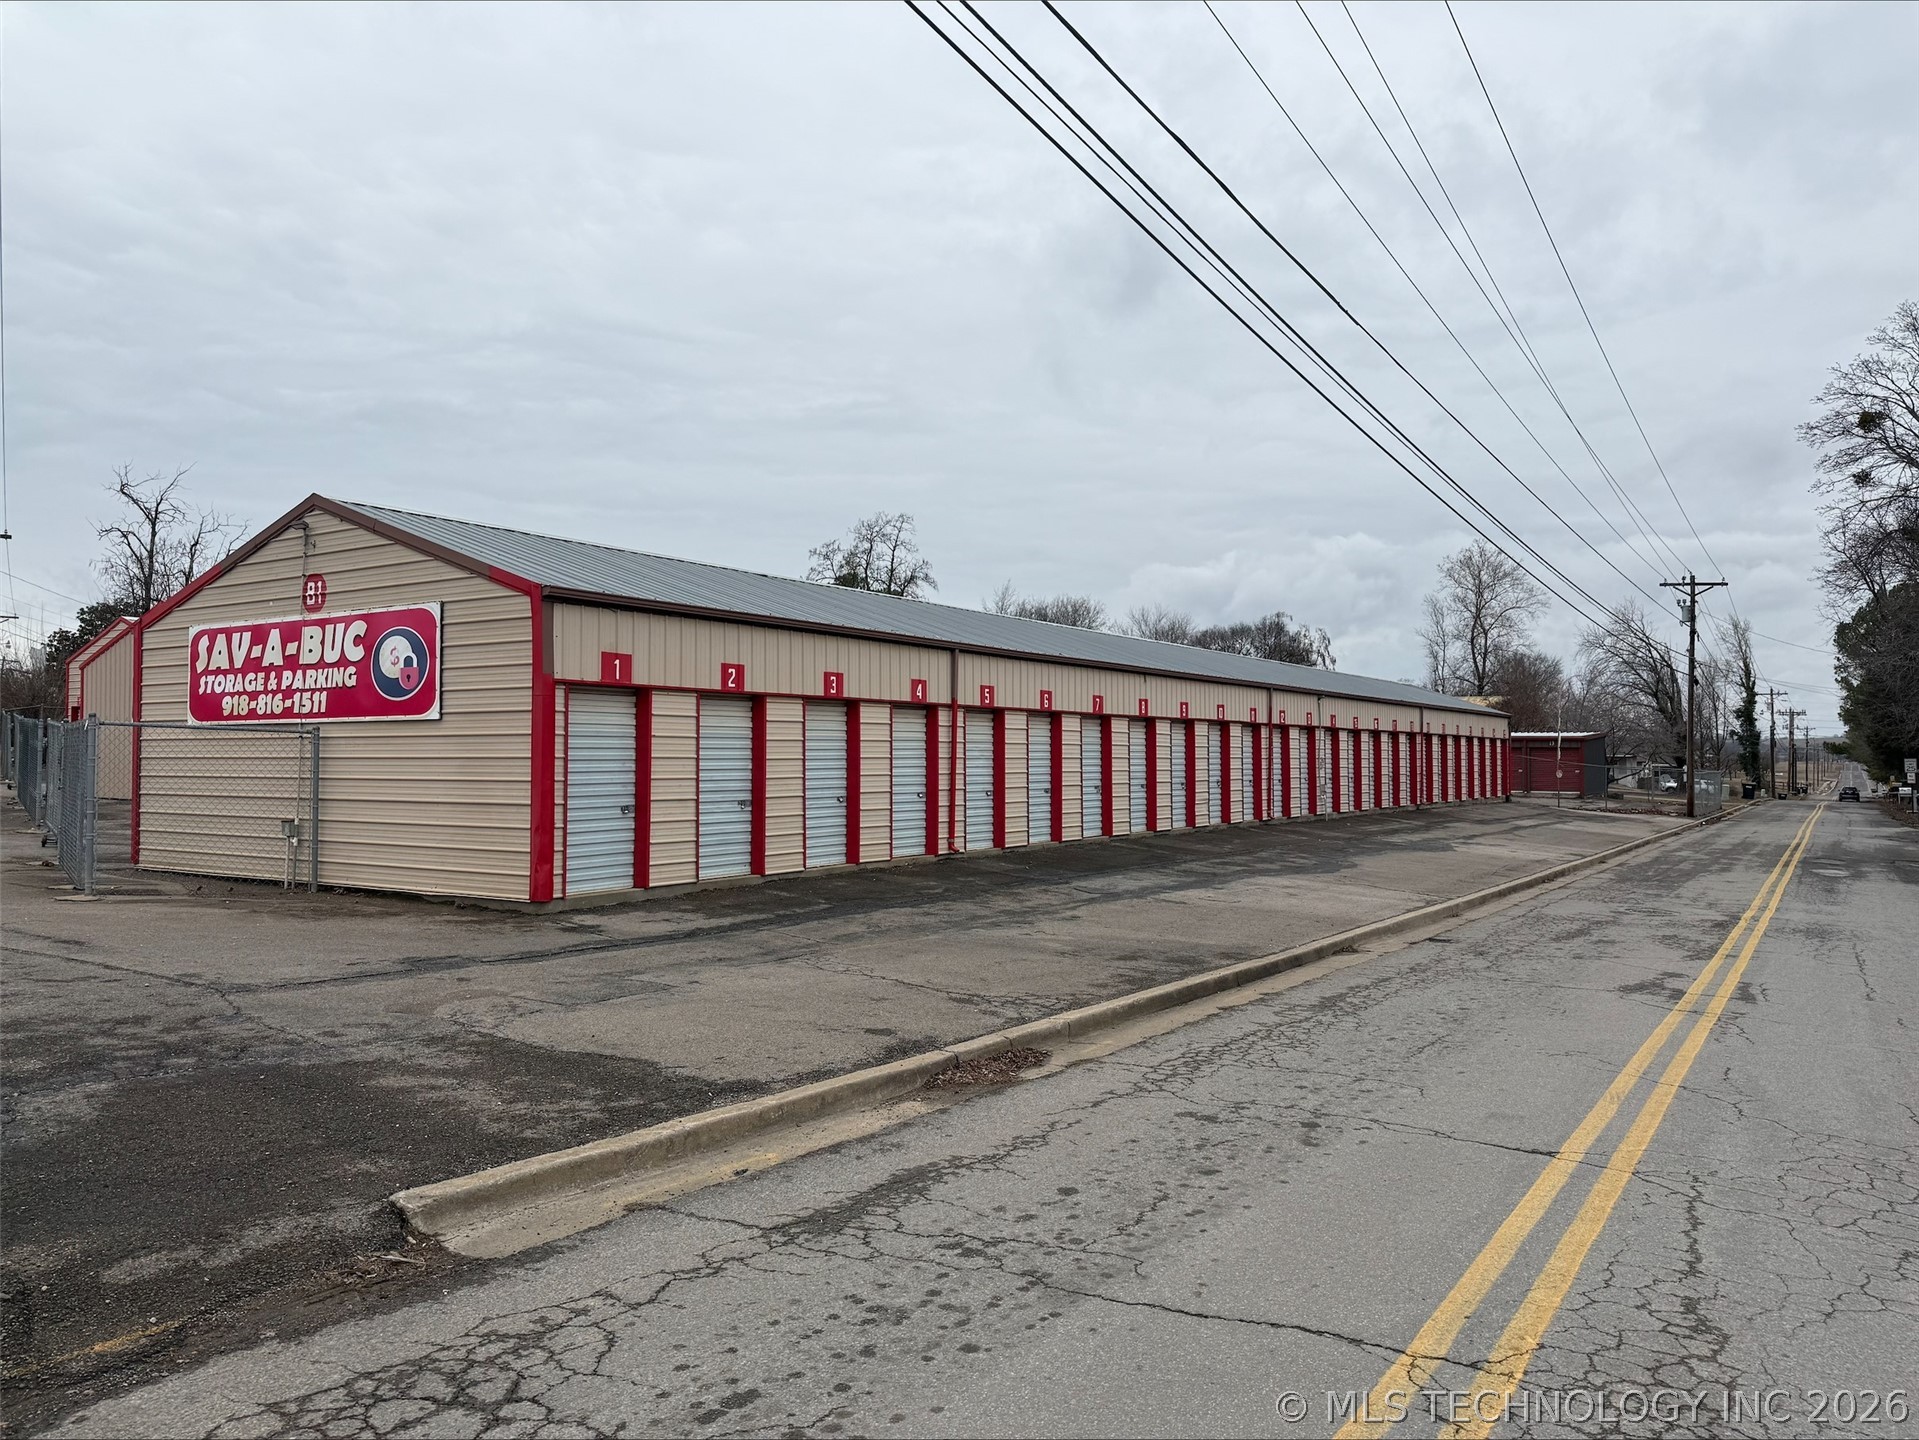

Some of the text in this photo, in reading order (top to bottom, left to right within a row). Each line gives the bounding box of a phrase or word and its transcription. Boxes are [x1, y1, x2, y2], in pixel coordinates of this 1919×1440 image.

[306, 580, 323, 606] B1
[195, 619, 368, 674] SAV-A-BUC
[613, 658, 621, 680] 1
[727, 668, 736, 688] 2
[198, 666, 357, 695] STORAGE & PARKING
[829, 675, 837, 695] 3
[915, 683, 923, 700] 4
[984, 688, 990, 704] 5
[1044, 693, 1049, 708] 6
[221, 690, 328, 717] 918-816-1511
[1095, 698, 1100, 711] 7
